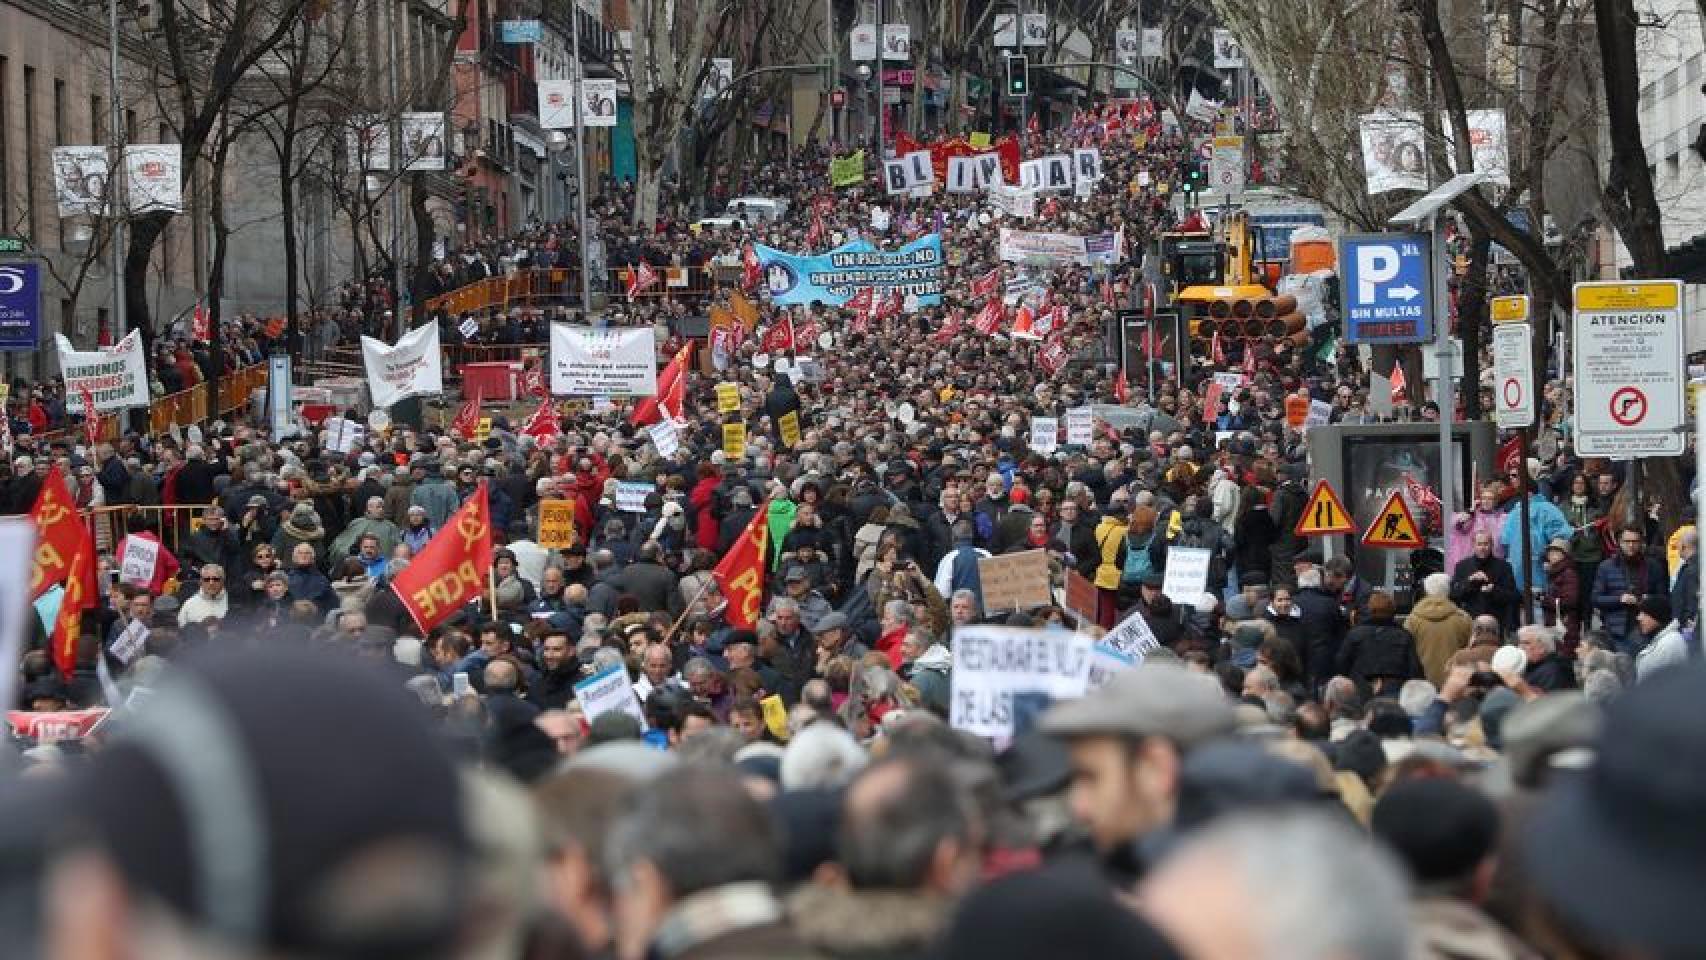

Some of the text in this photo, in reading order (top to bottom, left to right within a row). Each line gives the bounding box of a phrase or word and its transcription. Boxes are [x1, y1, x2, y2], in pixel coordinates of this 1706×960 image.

[1357, 245, 1399, 304] P
[1351, 305, 1422, 319] SIN MULTAS
